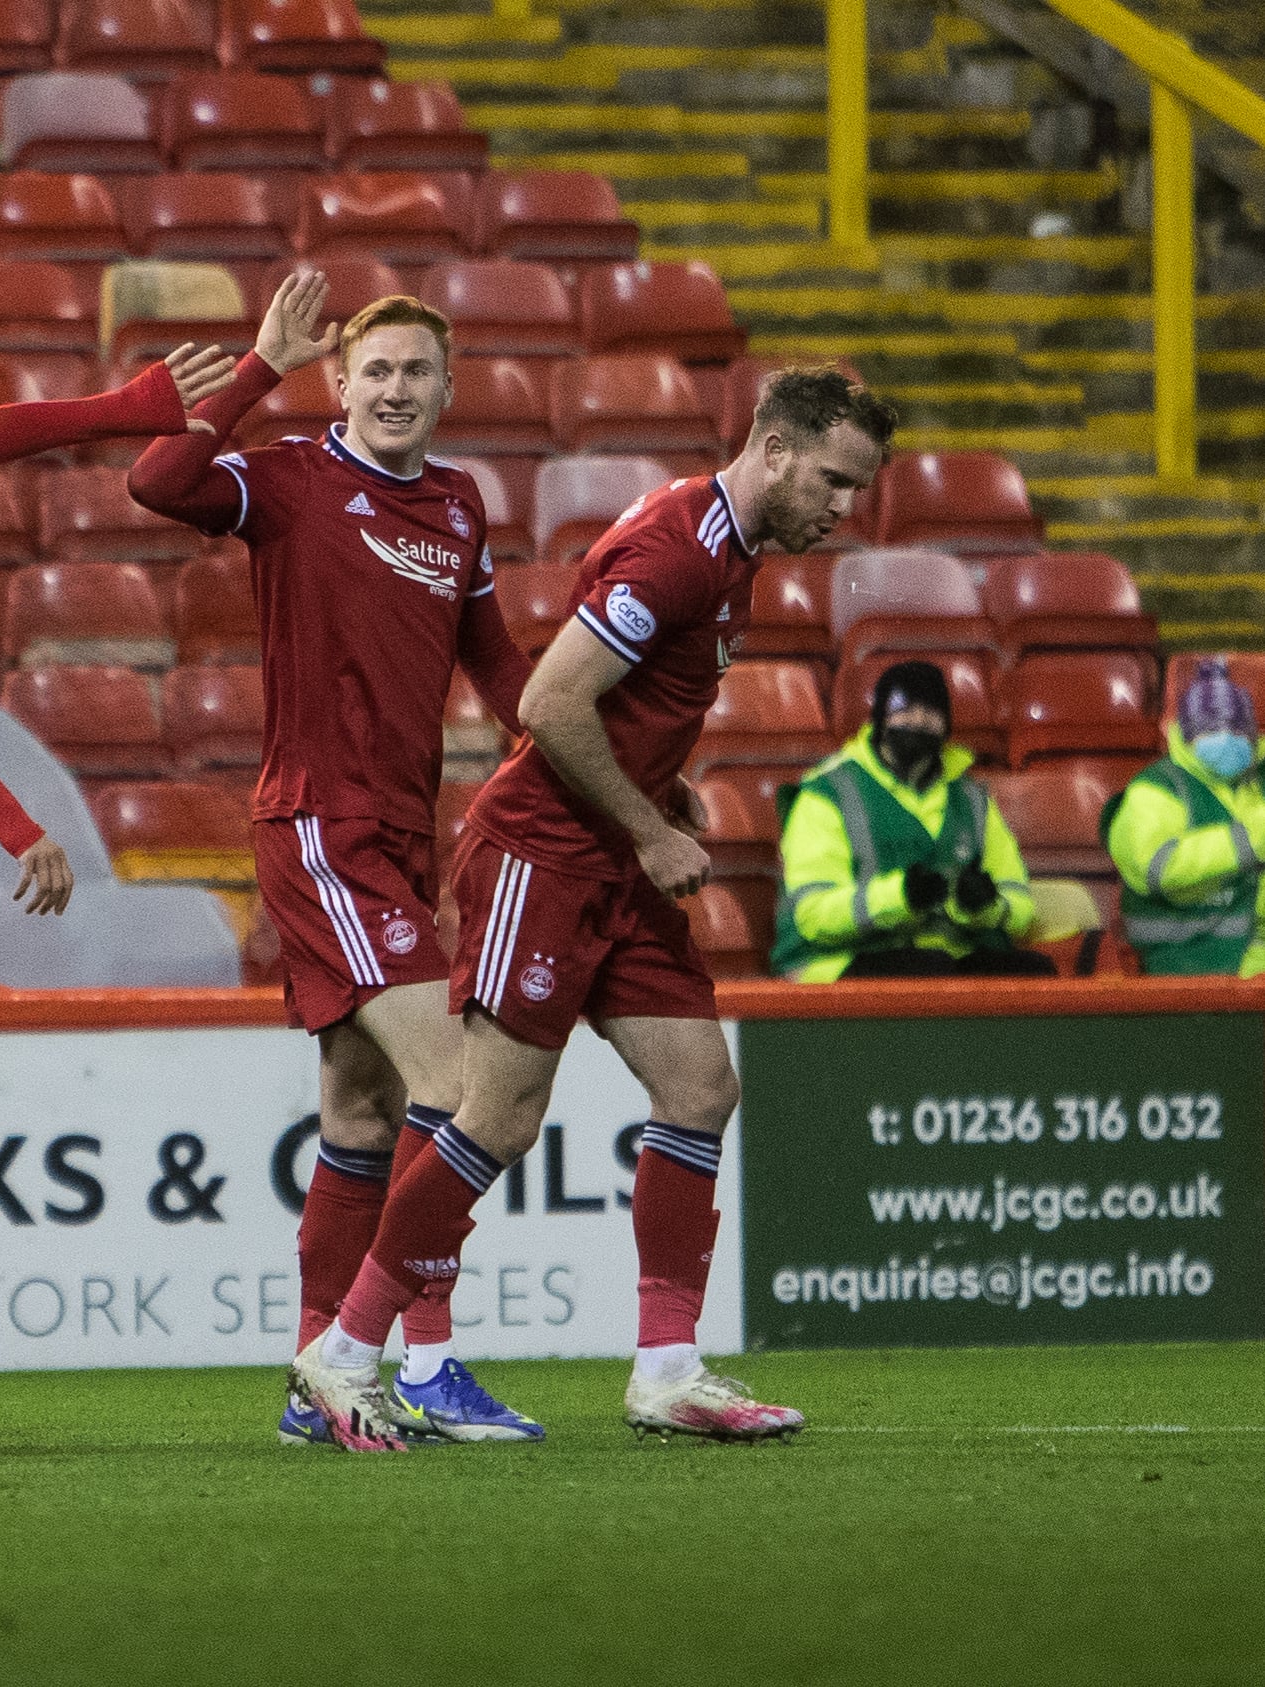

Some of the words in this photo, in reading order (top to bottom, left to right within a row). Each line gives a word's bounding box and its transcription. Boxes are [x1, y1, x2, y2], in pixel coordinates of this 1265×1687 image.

[396, 537, 461, 570] Saltire
[429, 585, 457, 602] energy
[618, 602, 651, 634] cinch
[867, 1103, 903, 1145] t:
[912, 1097, 1044, 1144] 01236
[1053, 1096, 1128, 1142] 316
[1137, 1094, 1223, 1140] 032
[145, 1131, 227, 1226] &
[867, 1172, 1223, 1232] www.jcgc.co.uk
[772, 1250, 1215, 1312] enquiries@jcgc.info
